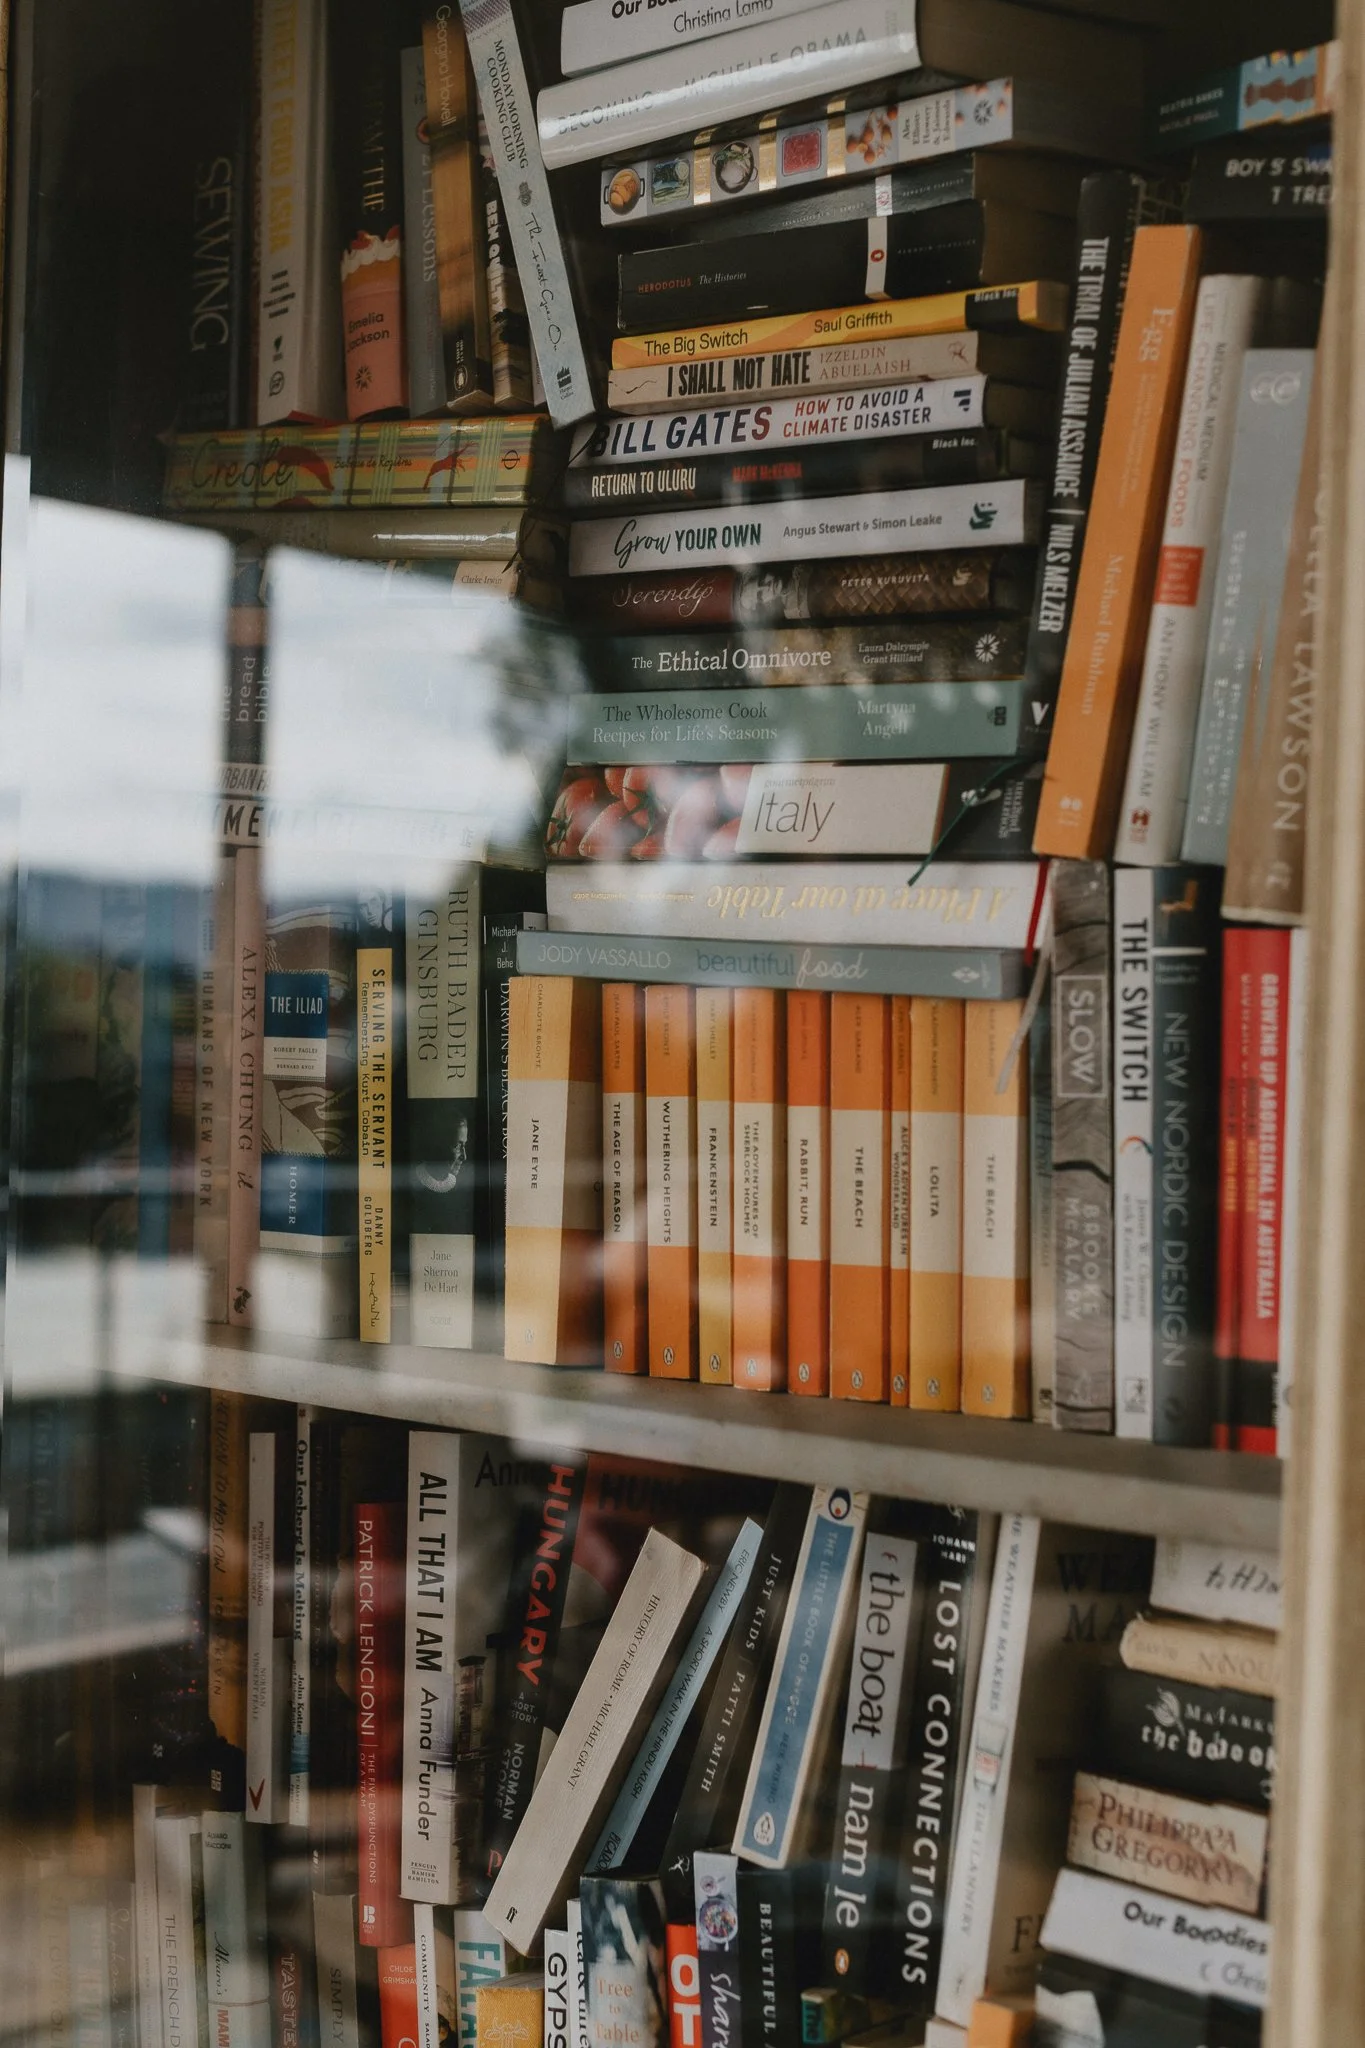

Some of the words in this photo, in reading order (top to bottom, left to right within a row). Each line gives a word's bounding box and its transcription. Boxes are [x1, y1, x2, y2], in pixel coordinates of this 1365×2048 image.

[612, 0, 642, 18] Our
[440, 75, 457, 126] Howell
[188, 156, 233, 353] SEWING
[1079, 236, 1110, 272] THE
[348, 310, 384, 334] Emelia
[814, 317, 842, 334] Saul
[844, 310, 893, 330] Griffith
[1074, 273, 1105, 323] TRIAL
[347, 326, 390, 352] Jackson
[644, 340, 670, 356] The
[674, 337, 695, 356] Big
[700, 328, 748, 349] Switch
[820, 346, 887, 364] IZZELDIN
[1070, 326, 1098, 351] OF
[667, 366, 674, 398] I
[678, 360, 726, 396] SHALL
[732, 357, 766, 392] NOT
[770, 351, 812, 387] HATE
[820, 359, 911, 380] ABUELAISH
[1062, 352, 1095, 417] JULIAN
[782, 414, 848, 439] CLIMATE
[854, 406, 932, 432] DISASTER
[794, 398, 832, 418] HOW
[836, 396, 854, 413] TO
[860, 388, 908, 411] AVOID
[914, 387, 924, 404] A
[590, 419, 658, 458] BILL
[666, 406, 773, 450] GATES
[189, 437, 295, 492] Creole
[592, 475, 636, 498] RETURN
[640, 471, 654, 494] TO
[657, 467, 697, 493] ULURU
[1054, 418, 1088, 500] ASSANGE
[613, 519, 672, 569] Grow
[674, 526, 718, 552] YOUR
[721, 523, 762, 548] OWN
[783, 524, 816, 540] Angus
[818, 521, 860, 535] Stewart
[863, 522, 869, 530] &
[872, 518, 907, 530] Simon
[910, 514, 942, 527] Leake
[1046, 524, 1075, 564] NILS
[1038, 565, 1070, 634] MELZER
[632, 656, 653, 670] The
[658, 648, 728, 673] Ethical
[732, 646, 832, 670] Omnivore
[1152, 616, 1177, 711] ANTHONY
[592, 727, 645, 748] Recipes
[650, 726, 672, 742] for
[676, 726, 714, 741] Life's
[718, 724, 778, 740] Seasons
[603, 706, 632, 722] The
[636, 704, 723, 721] Wholesome
[728, 702, 768, 720] Cook
[1272, 641, 1318, 830] LAWSON
[1140, 718, 1161, 797] WILLIAM
[754, 790, 835, 843] Italy
[447, 887, 469, 970] RUTH
[492, 925, 518, 936] Michael
[1120, 918, 1149, 973] THE
[496, 958, 514, 969] Behe
[538, 944, 583, 963] JODY
[588, 948, 672, 970] VASSALLO
[270, 996, 292, 1014] THE
[296, 998, 323, 1016] ILIAD
[372, 968, 385, 1044] SERVING
[417, 908, 438, 1062] GINSBURG
[202, 970, 214, 1052] HUMANS
[360, 982, 370, 1066] Remembering
[447, 982, 468, 1080] BADER
[1067, 988, 1097, 1084] SLOW
[1260, 972, 1279, 1057] GROWING
[372, 1052, 386, 1084] THE
[1121, 987, 1149, 1102] SWITCH
[1162, 1012, 1190, 1089] NEW
[202, 1066, 214, 1090] OF
[361, 1074, 370, 1102] Kurt
[1260, 1060, 1278, 1084] UP
[200, 1102, 212, 1144] NEW
[362, 1110, 370, 1156] Cobain
[372, 1094, 385, 1168] SERVANT
[531, 1118, 540, 1152] JANE
[613, 1102, 621, 1128] THE
[613, 1130, 621, 1156] AGE
[662, 1100, 671, 1182] WUTHERING
[799, 1138, 808, 1192] RABBIT,
[854, 1146, 864, 1174] THE
[1162, 1100, 1190, 1227] NORDIC
[1258, 1088, 1278, 1194] ABORIGINAL
[200, 1156, 212, 1206] YORK
[614, 1160, 621, 1176] OF
[709, 1127, 718, 1227] FRANKENSTEIN
[930, 1165, 940, 1218] LOLITA
[986, 1154, 996, 1184] THE
[288, 1166, 298, 1225] HOMER
[613, 1181, 621, 1233] REASON
[663, 1186, 671, 1244] HEIGHTS
[800, 1196, 808, 1226] RUN
[854, 1179, 864, 1228] BEACH
[986, 1190, 995, 1240] BEACH
[1258, 1200, 1276, 1221] IN
[364, 1196, 372, 1256] GOLDBERG
[374, 1208, 384, 1247] DANNY
[423, 1264, 459, 1278] Sherron
[430, 1250, 452, 1261] Jane
[1081, 1203, 1102, 1318] BROOKE
[1256, 1224, 1276, 1320] AUSTRALIA
[423, 1282, 438, 1293] De
[438, 1282, 459, 1294] Hart
[1160, 1240, 1189, 1368] DESIGN
[296, 1439, 308, 1476] Our
[296, 1479, 308, 1547] Iceberg
[418, 1471, 448, 1522] ALL
[295, 1550, 306, 1566] Is
[358, 1520, 374, 1613] PATRICK
[417, 1532, 446, 1604] THAT
[516, 1463, 576, 1686] HUNGARY
[762, 1552, 782, 1601] JUST
[294, 1572, 307, 1641] Melting
[416, 1610, 444, 1620] I
[746, 1606, 766, 1650] KIDS
[866, 1569, 906, 1637] the
[932, 1579, 962, 1676] LOST
[415, 1627, 444, 1672] AM
[359, 1623, 376, 1736] LENCIONI
[721, 1670, 746, 1730] PATTI
[852, 1644, 896, 1739] boat
[418, 1687, 439, 1750] Anna
[368, 1752, 376, 1772] THE
[502, 1742, 526, 1821] NORMAN
[700, 1730, 726, 1794] SMITH
[368, 1777, 376, 1800] FIVE
[417, 1759, 437, 1842] Funder
[368, 1802, 376, 1885] DYSFUNCTIONS
[842, 1781, 875, 1878] nam
[902, 1692, 952, 1985] CONNECTIONS
[407, 1874, 440, 1886] HAMILTON
[410, 1860, 438, 1871] PENGUIN
[411, 1870, 436, 1878] HAMISH
[164, 1914, 177, 1948] THE
[834, 1884, 867, 1929] le
[166, 1954, 181, 2030] FRENCH
[389, 1964, 416, 1975] CHLOE
[596, 1980, 634, 1998] Tree
[759, 1902, 777, 2034] BEAUTIFUL
[330, 1968, 344, 2044] SIMPLY
